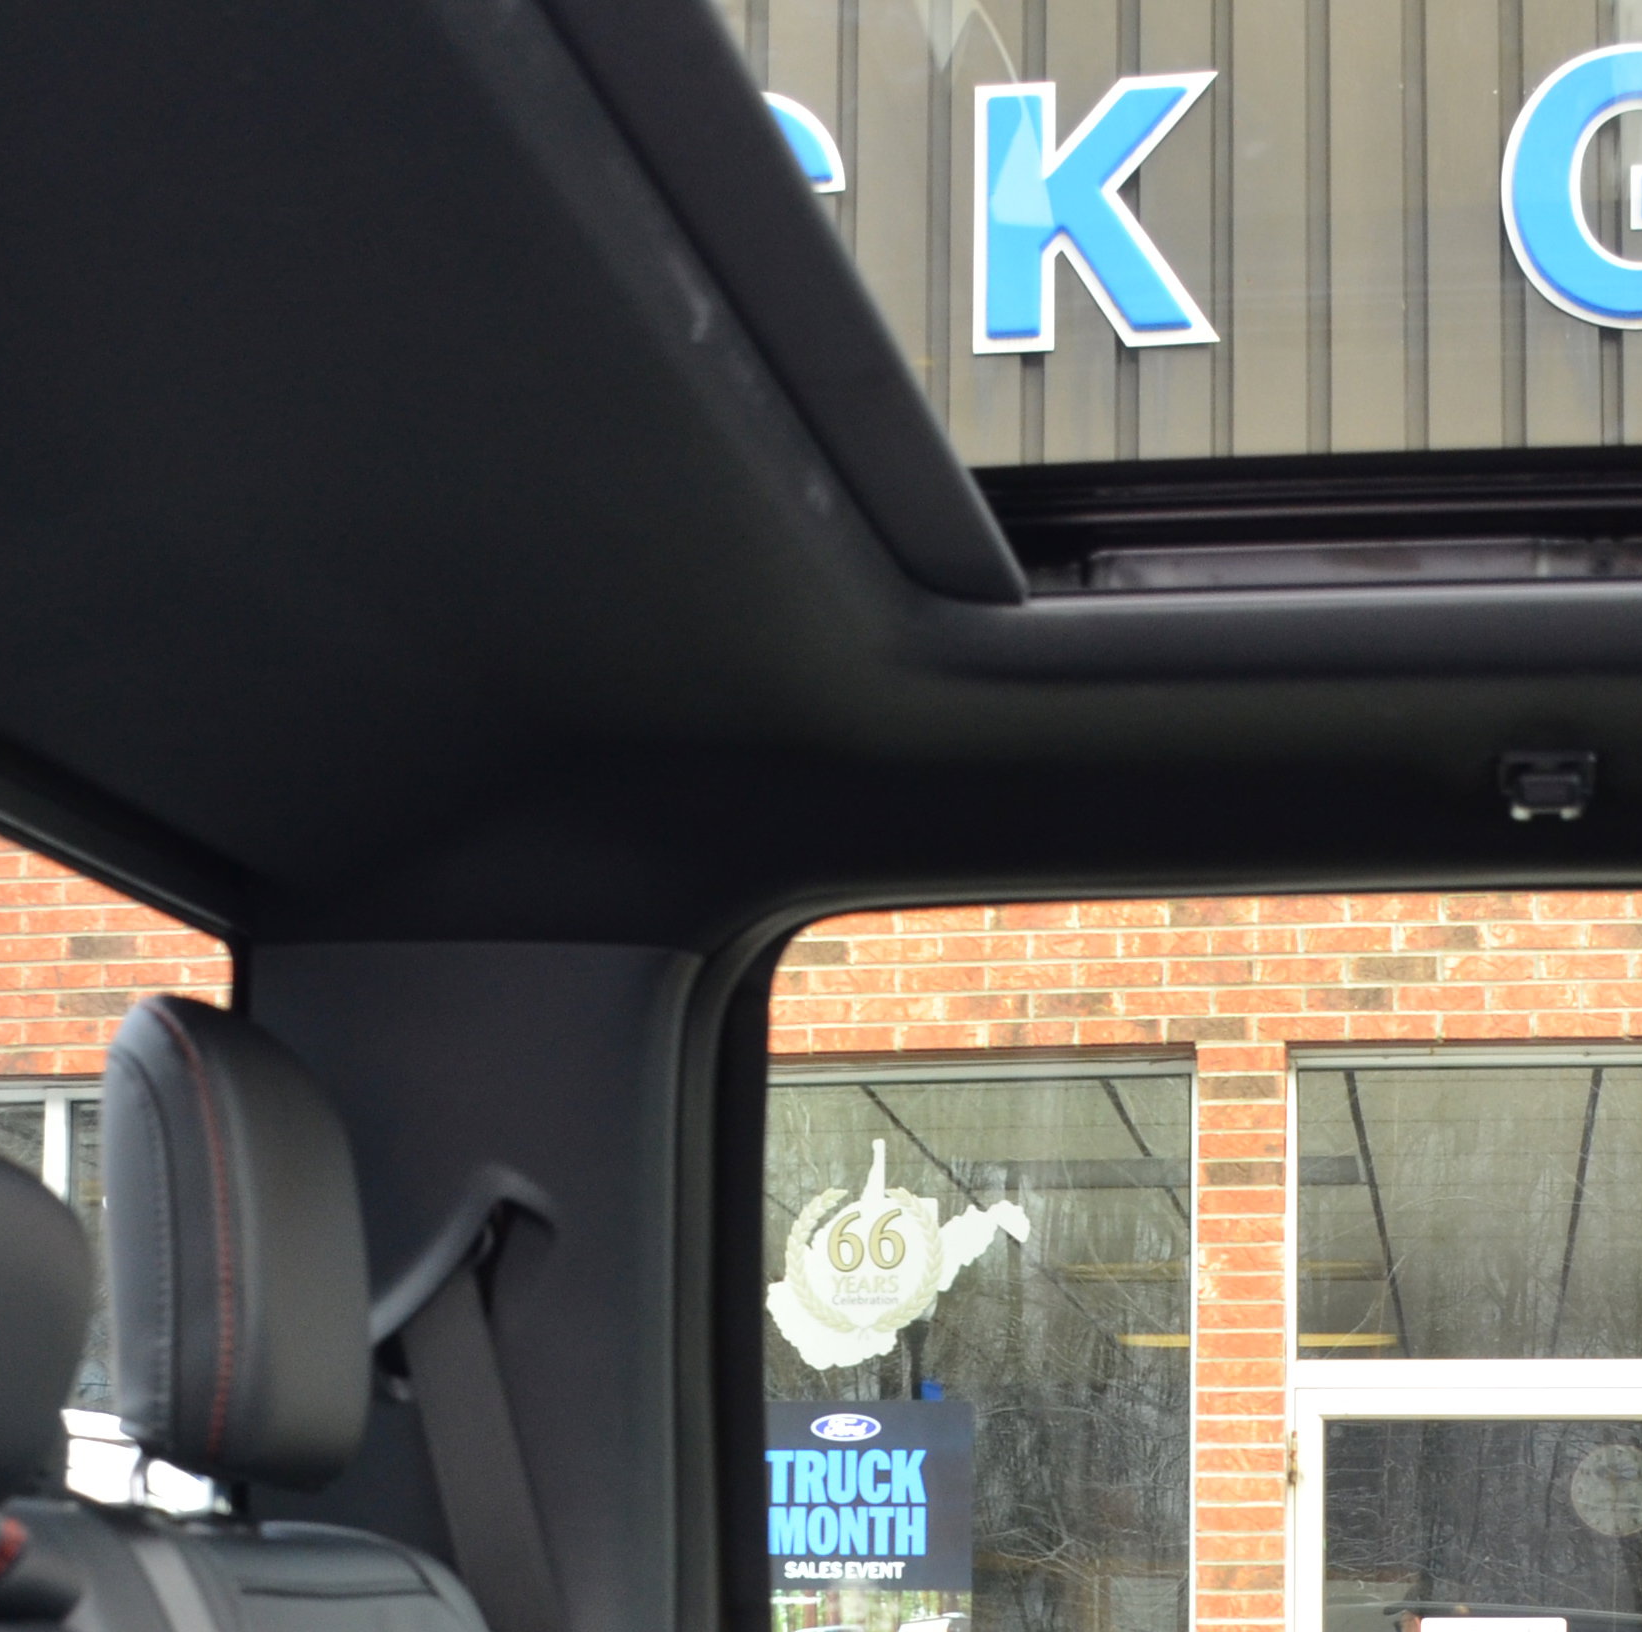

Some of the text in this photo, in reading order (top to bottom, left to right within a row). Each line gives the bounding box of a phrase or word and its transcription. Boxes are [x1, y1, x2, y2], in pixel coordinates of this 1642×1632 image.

[827, 1207, 906, 1273] 66
[831, 1274, 900, 1294] YEARS
[831, 1294, 900, 1306] Celebration
[765, 1449, 928, 1505] TRUCK
[767, 1505, 928, 1556] MONTH
[784, 1560, 906, 1580] SALES EVENT
